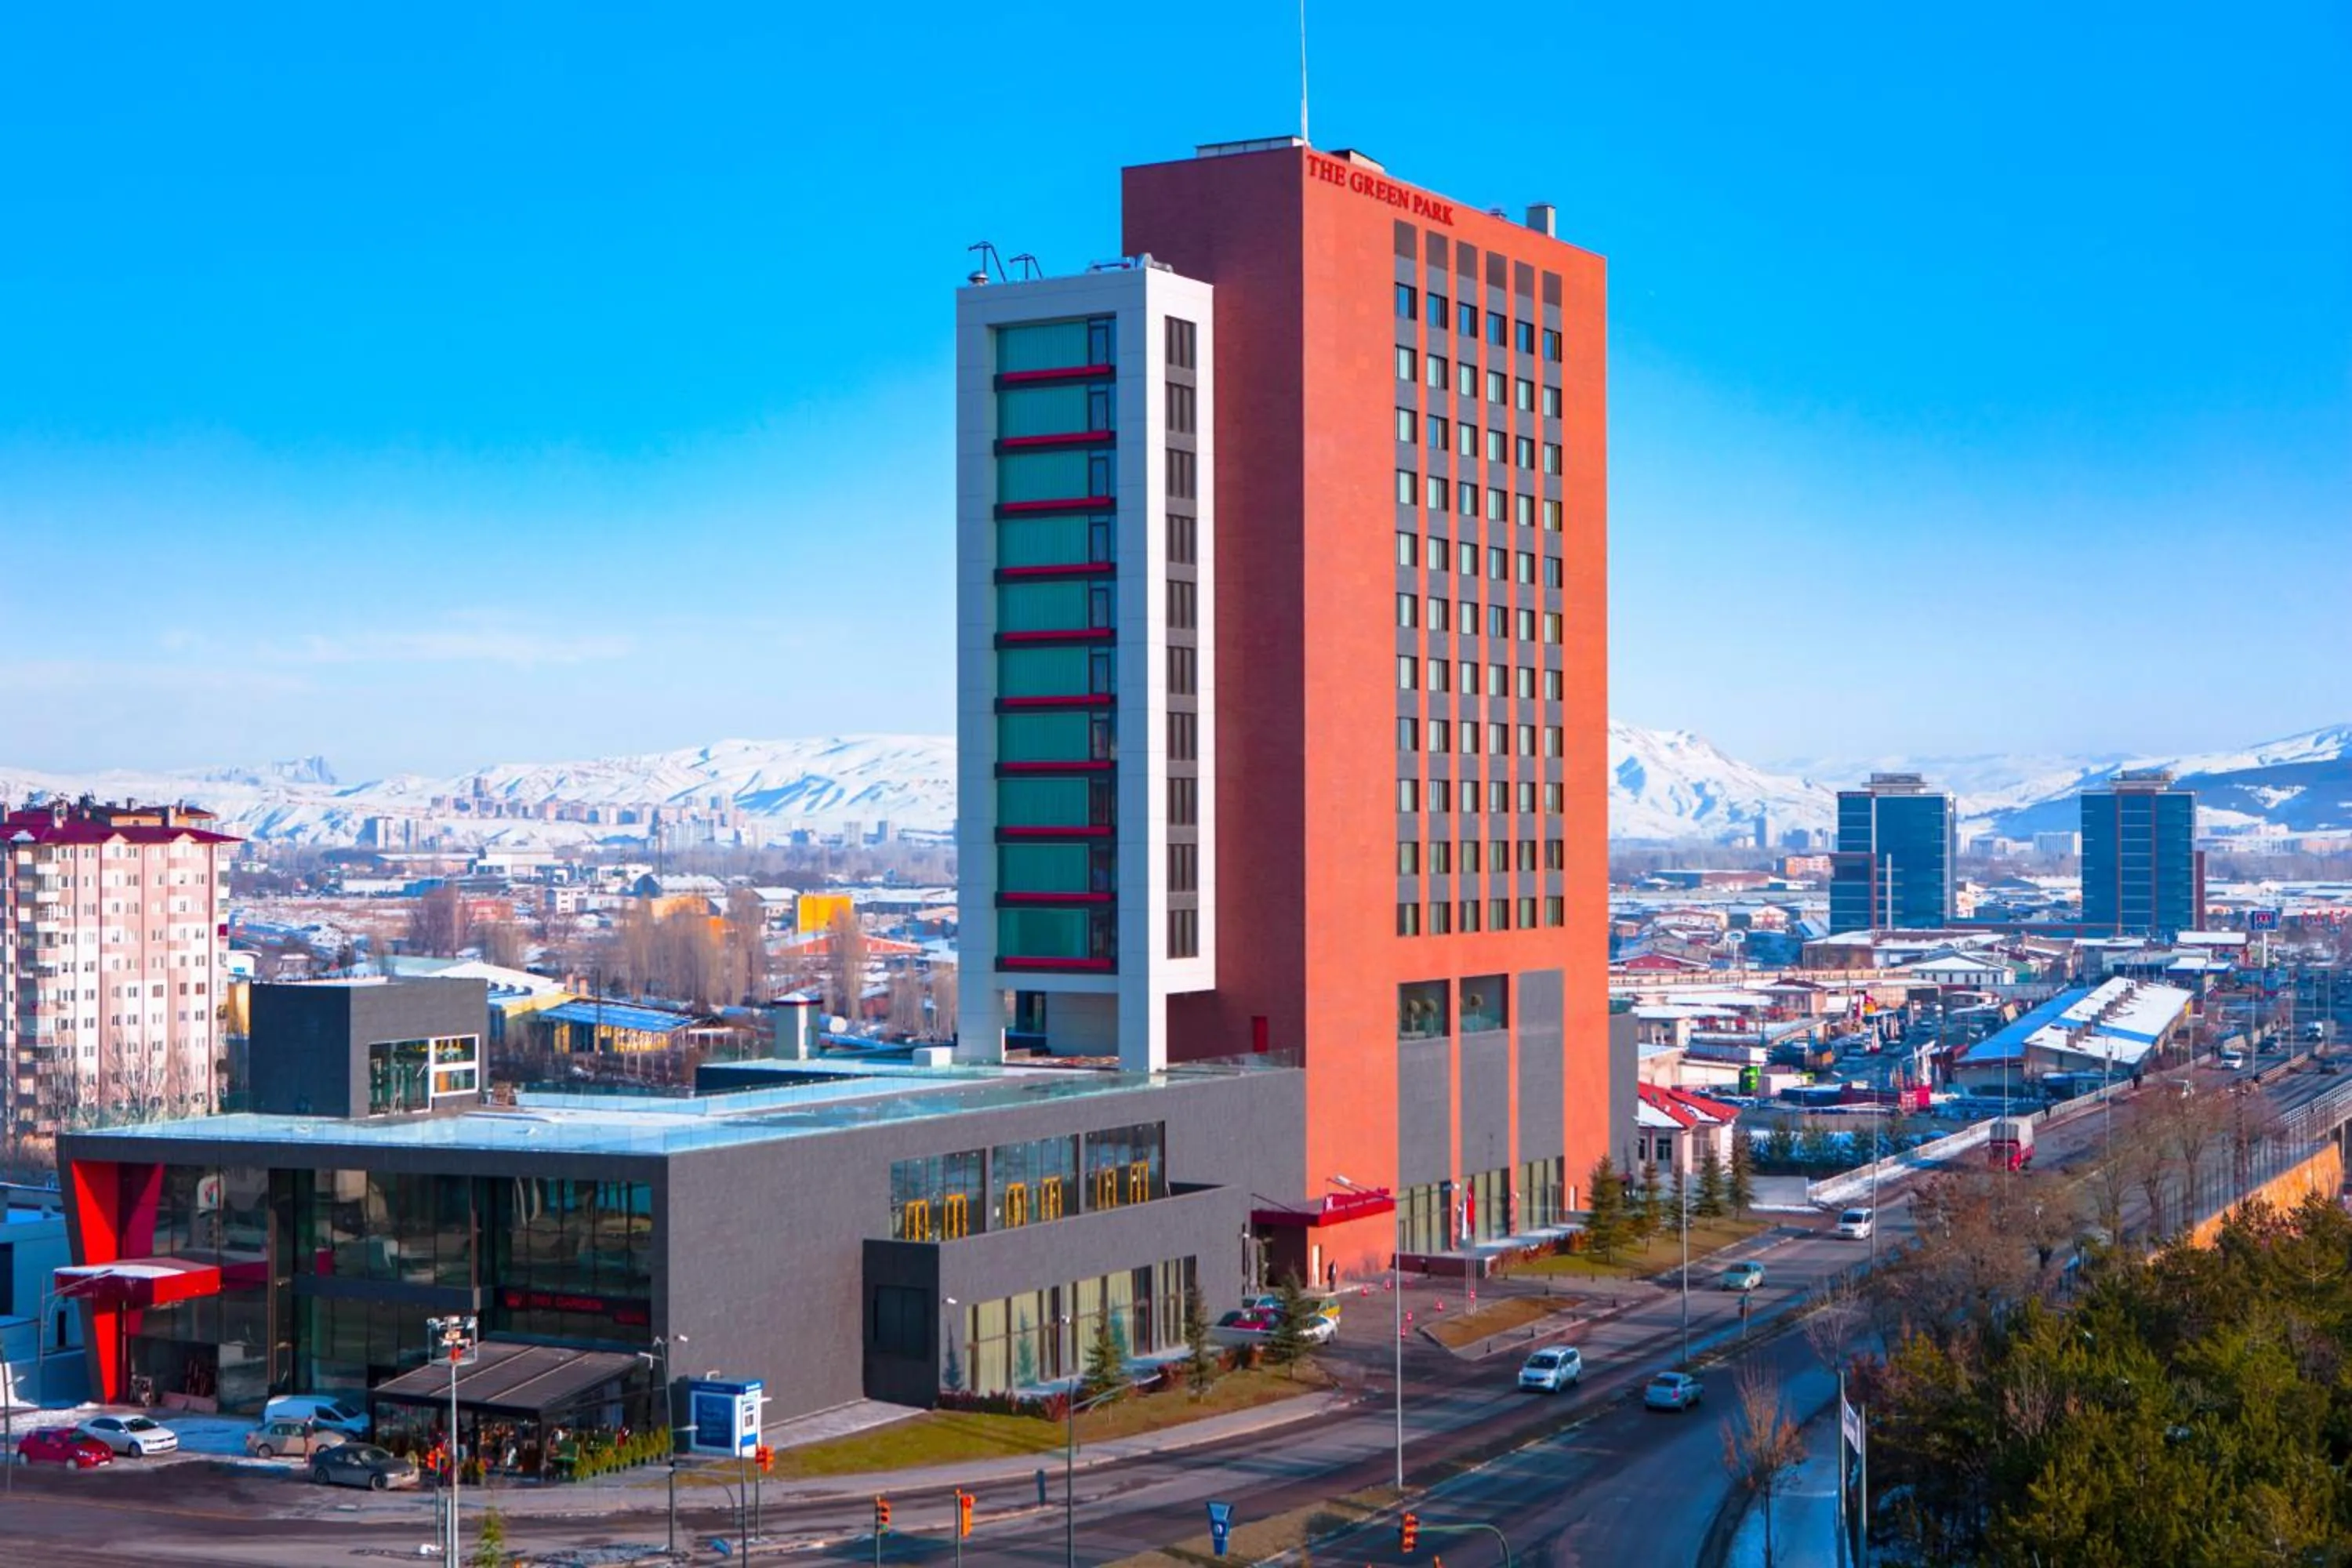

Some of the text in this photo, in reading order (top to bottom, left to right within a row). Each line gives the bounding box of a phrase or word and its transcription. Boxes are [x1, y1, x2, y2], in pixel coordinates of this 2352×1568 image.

[1307, 155, 1454, 226] THE GREEN PARK
